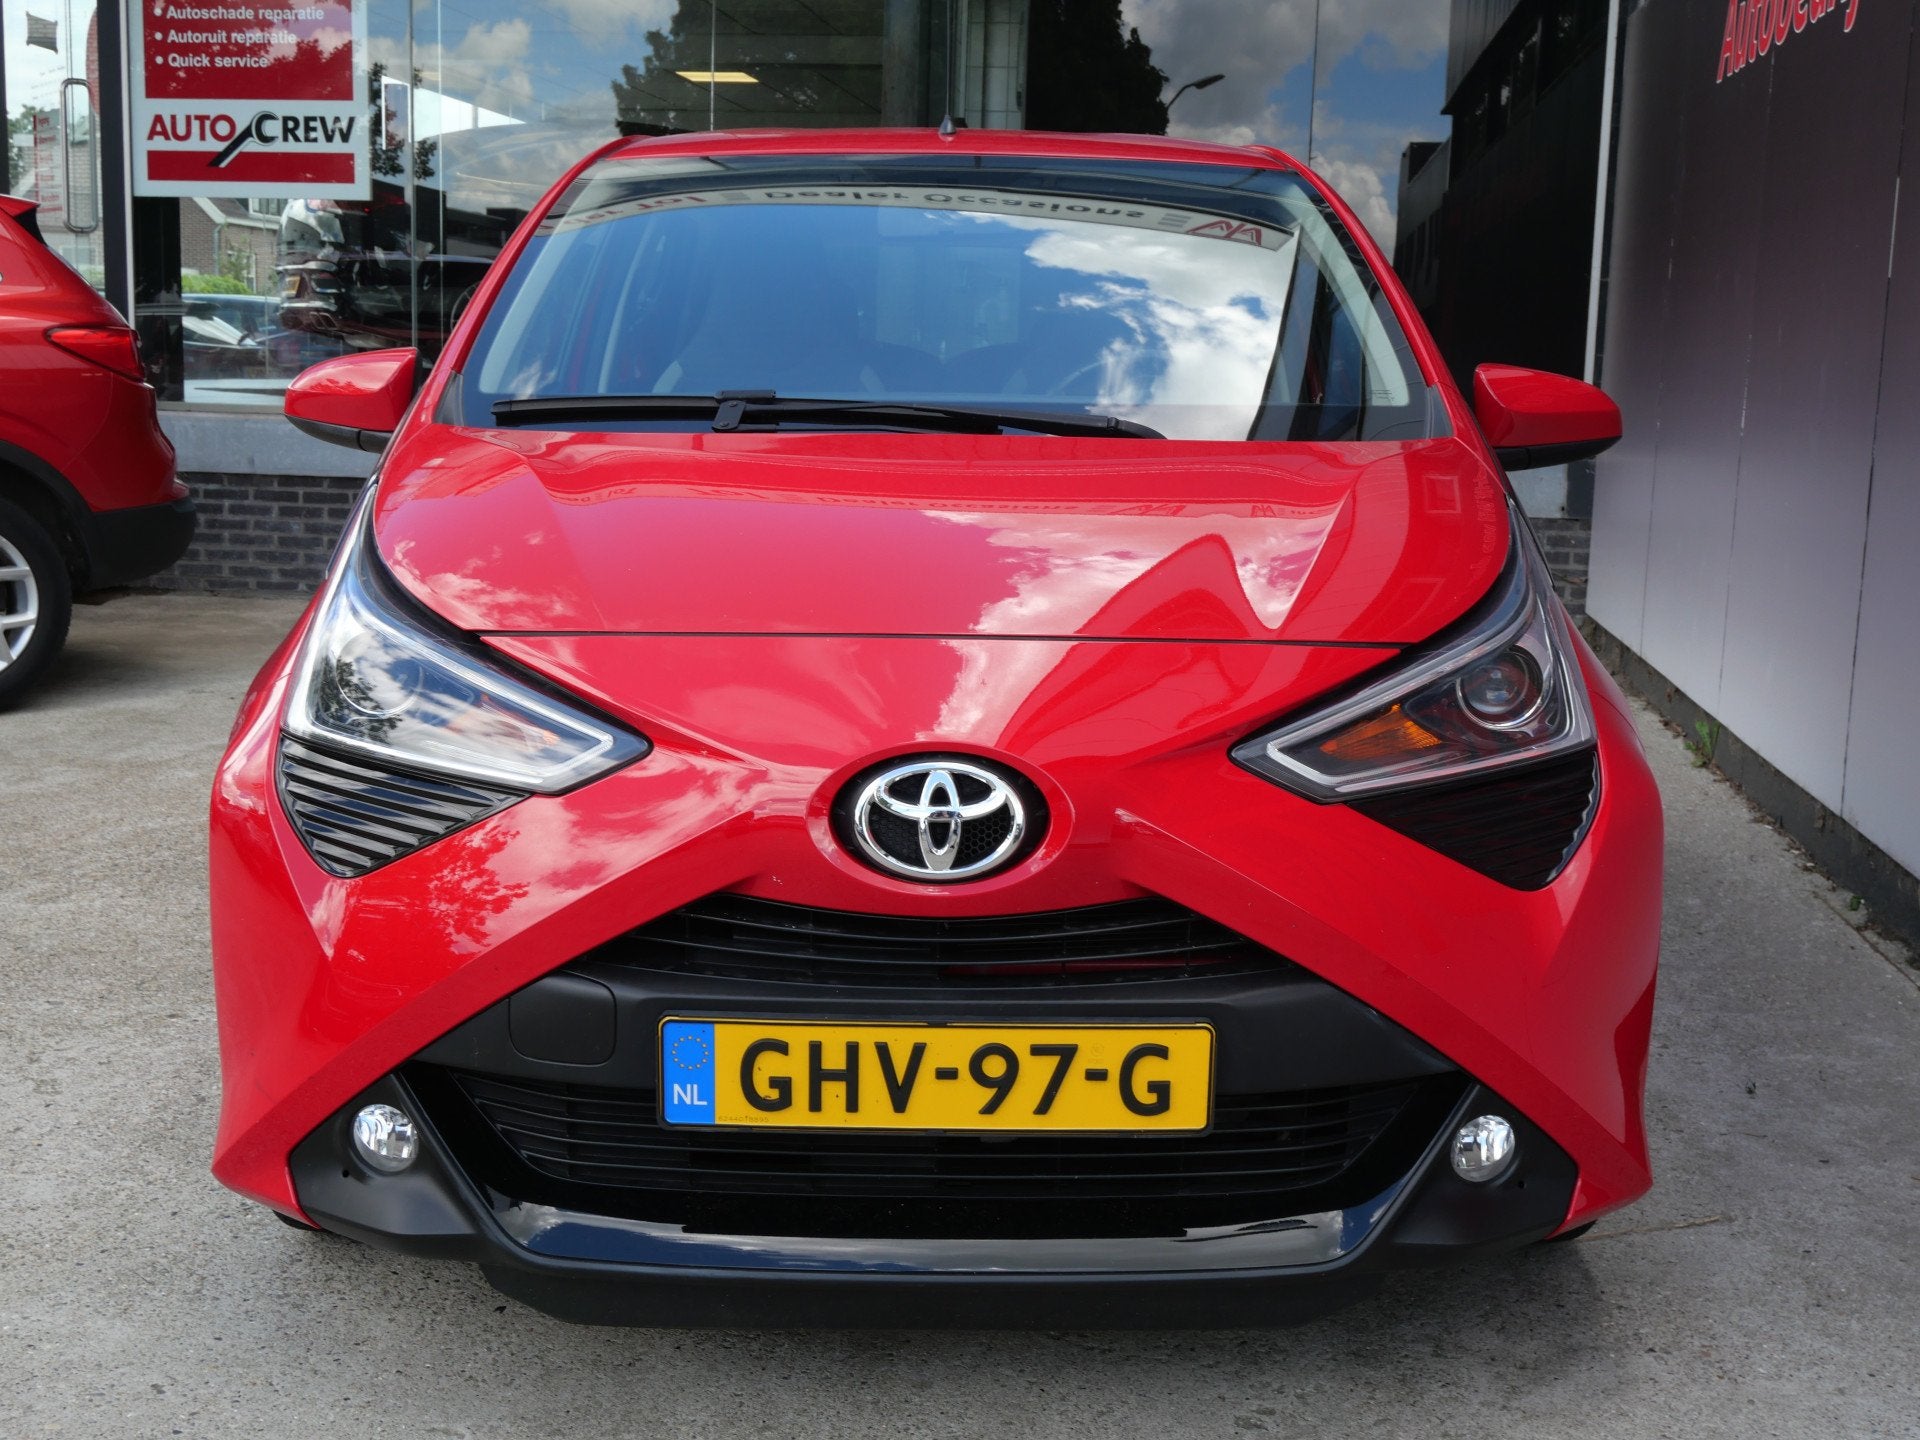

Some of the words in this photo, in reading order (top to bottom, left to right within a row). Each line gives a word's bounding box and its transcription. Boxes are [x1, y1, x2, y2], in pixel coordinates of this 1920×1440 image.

[166, 6, 254, 20] Autoschade
[259, 7, 324, 23] reparatie
[167, 29, 227, 44] Autoruit
[231, 30, 297, 46] reparatie
[168, 53, 211, 68] Quick
[214, 54, 268, 68] service
[739, 1038, 1171, 1116] GHV-97-G
[673, 1083, 708, 1106] NL
